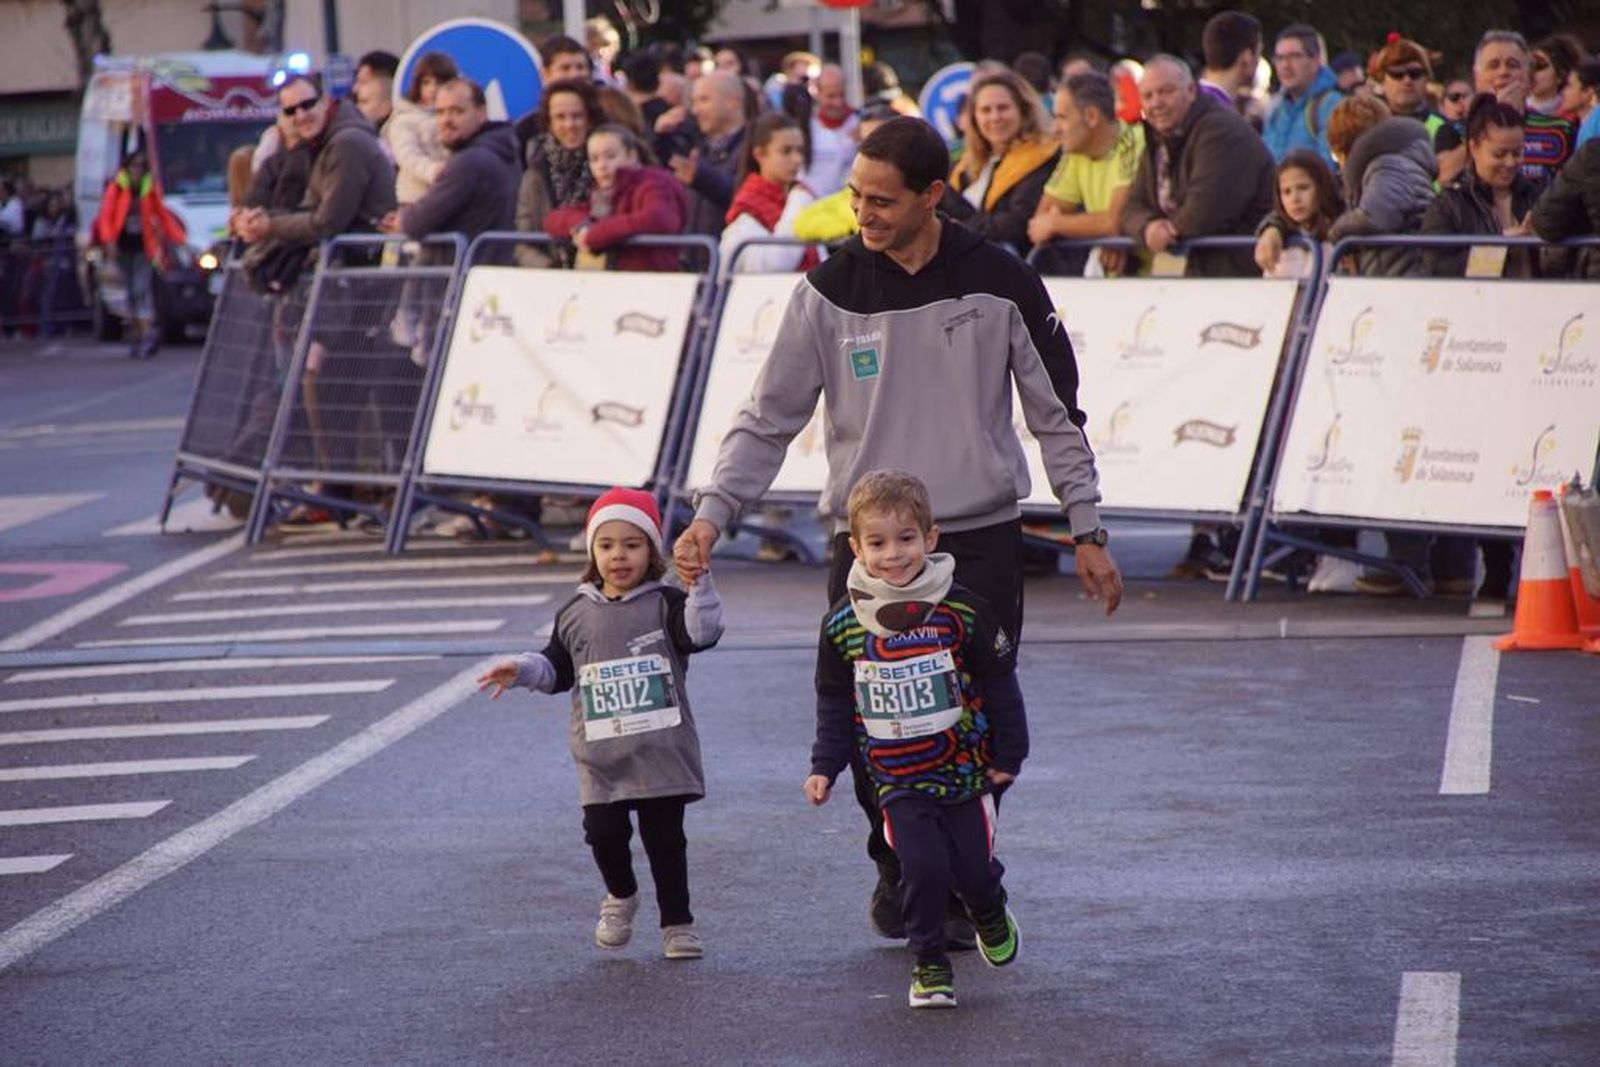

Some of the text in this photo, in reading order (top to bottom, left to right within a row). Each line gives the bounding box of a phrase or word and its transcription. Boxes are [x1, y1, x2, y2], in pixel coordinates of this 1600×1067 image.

[600, 659, 661, 679] SETEL
[879, 658, 944, 679] SETEL
[592, 678, 654, 713] 6302
[869, 678, 936, 713] 6303
